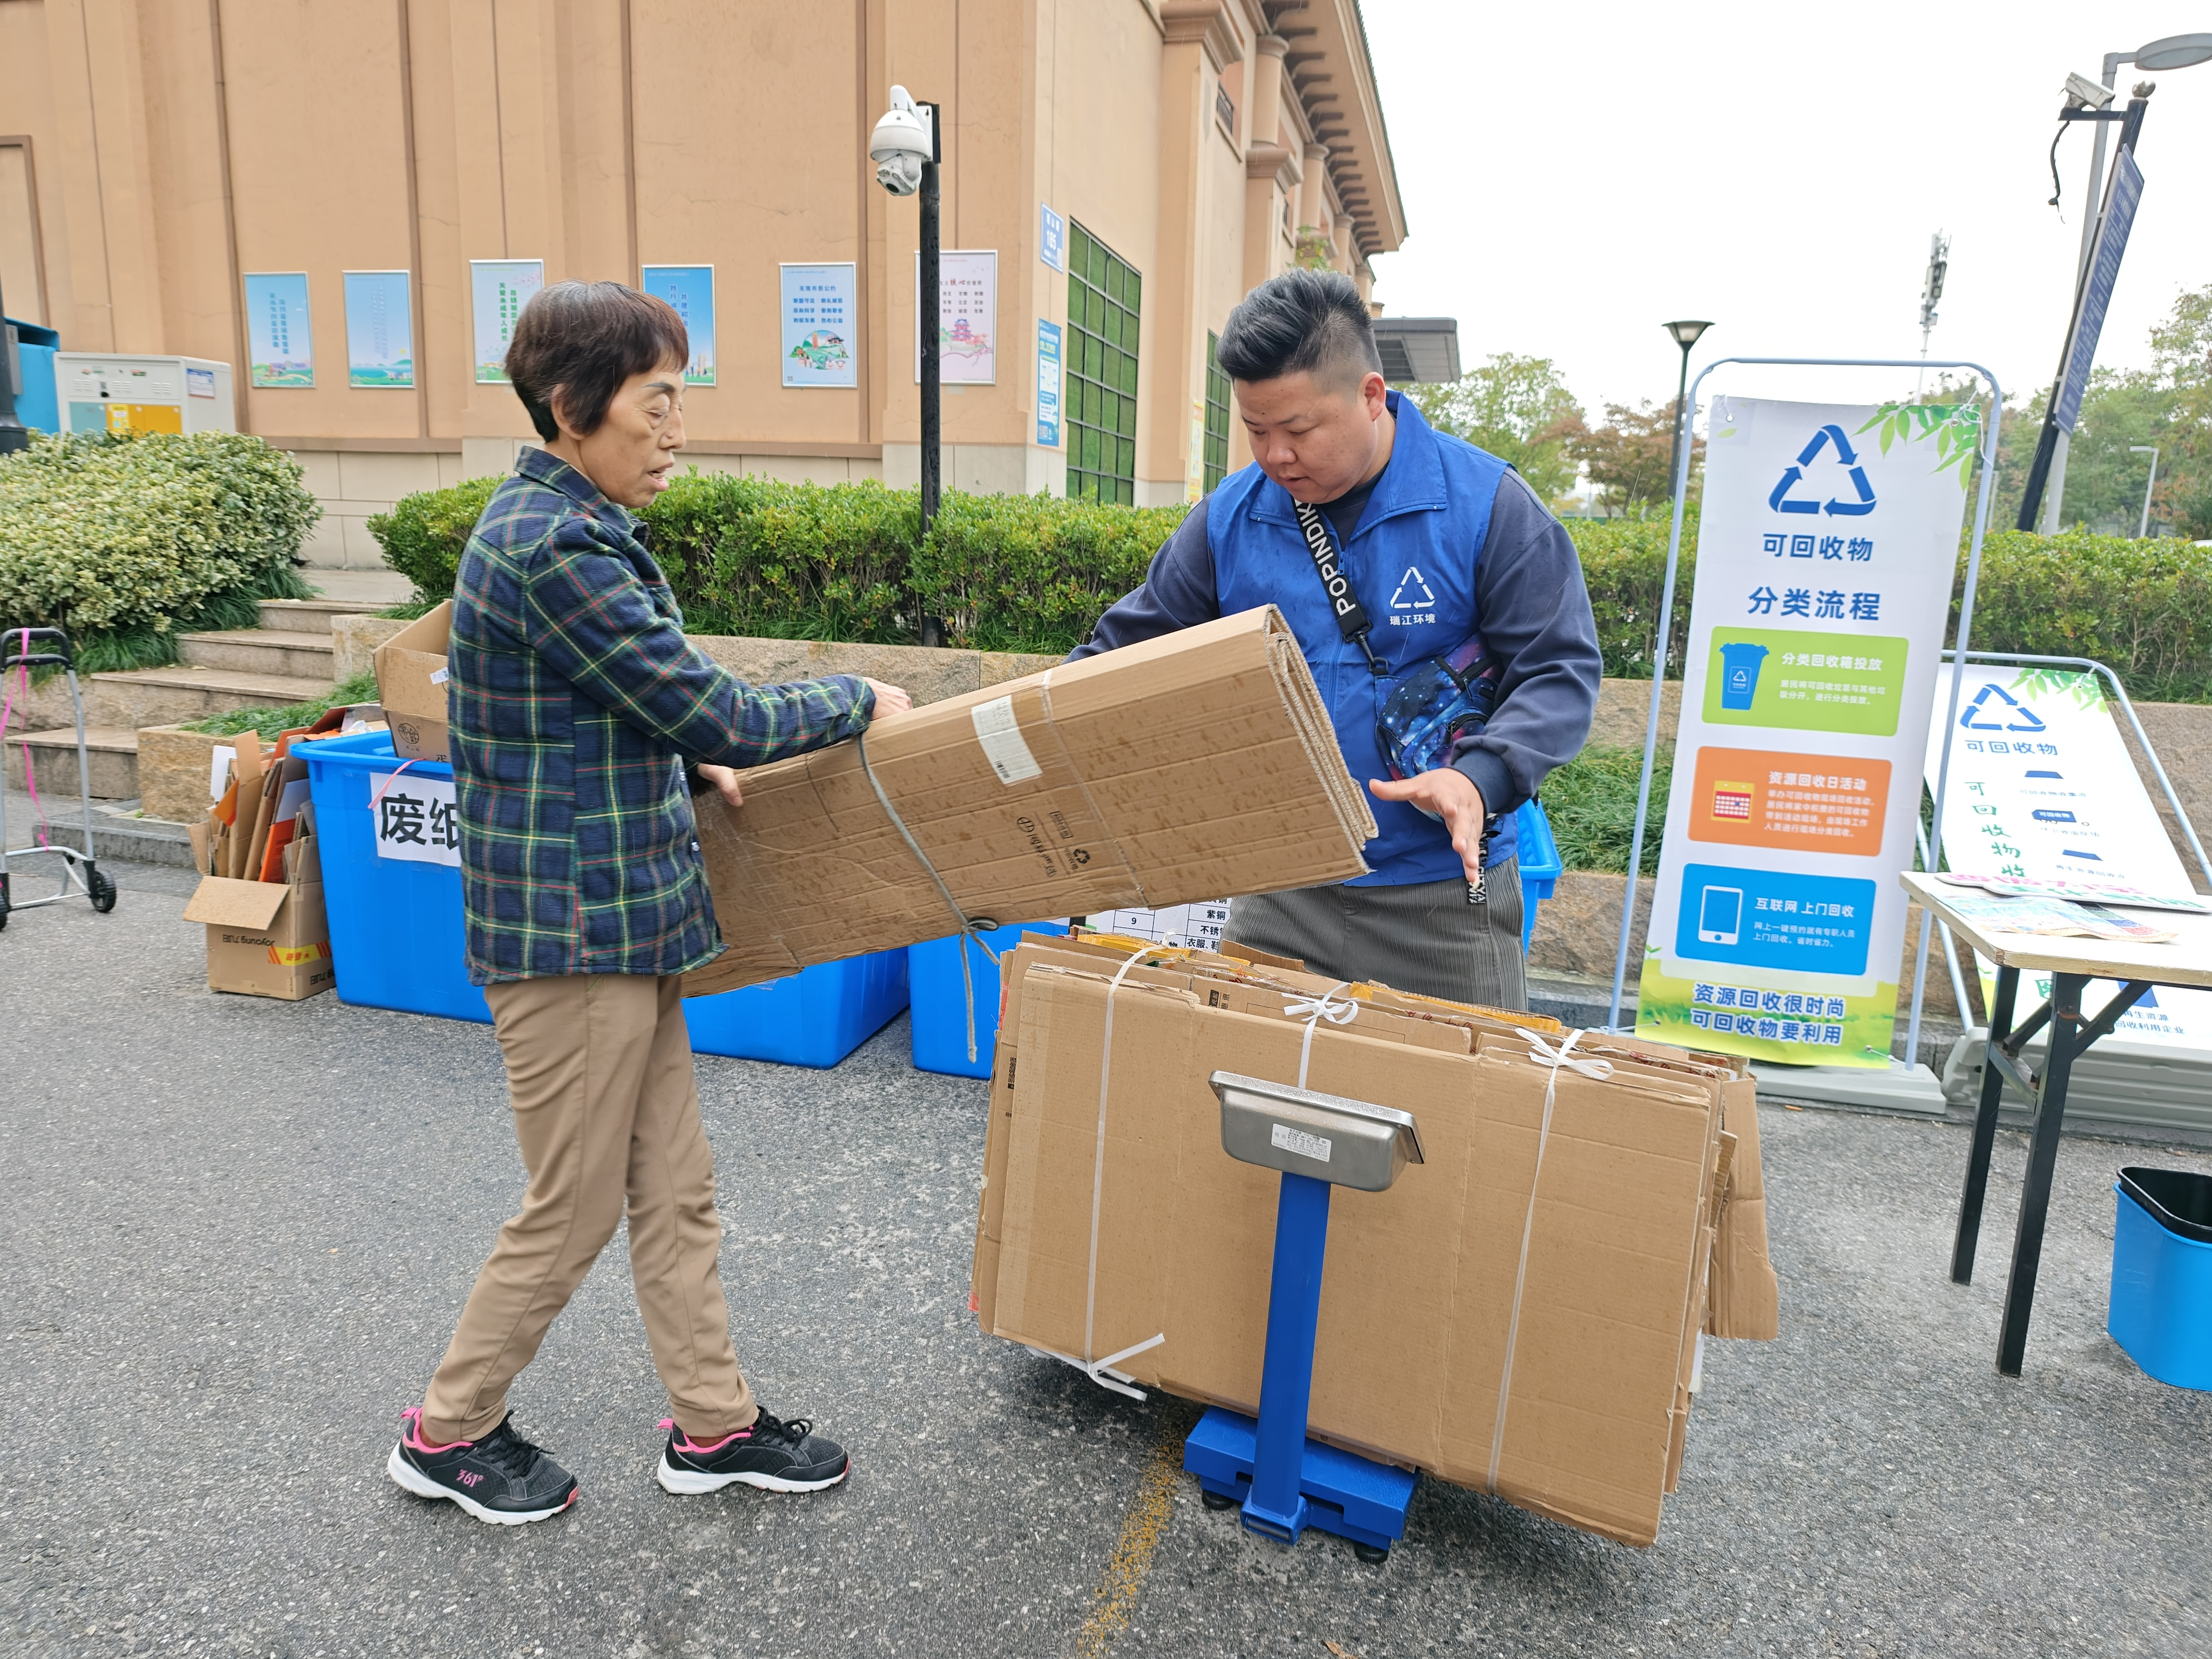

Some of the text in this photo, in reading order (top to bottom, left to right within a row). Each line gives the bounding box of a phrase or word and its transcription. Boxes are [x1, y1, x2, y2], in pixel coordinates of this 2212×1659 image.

[1763, 532, 1874, 562] 可回收物
[1748, 586, 1880, 621] 分类流程
[1390, 613, 1436, 626] 瑞江环境
[1782, 651, 1883, 671] 分类回收箱投放
[1965, 739, 2058, 756] 可回收物
[1769, 771, 1867, 791] 资源回收日活动
[380, 792, 458, 850] 废纸
[1206, 909, 1226, 921] 紫铜
[1755, 897, 1855, 918] 互联网 上门回收
[1200, 926, 1223, 936] 不锈
[1754, 921, 1855, 938] 网上一键预约就有专职人员
[1694, 982, 1846, 1019] 资源回收很时尚
[2123, 1010, 2170, 1021] 再生资源
[1690, 1009, 1843, 1046] 可回收物要利用
[2114, 1020, 2186, 1035] 回收利用企业
